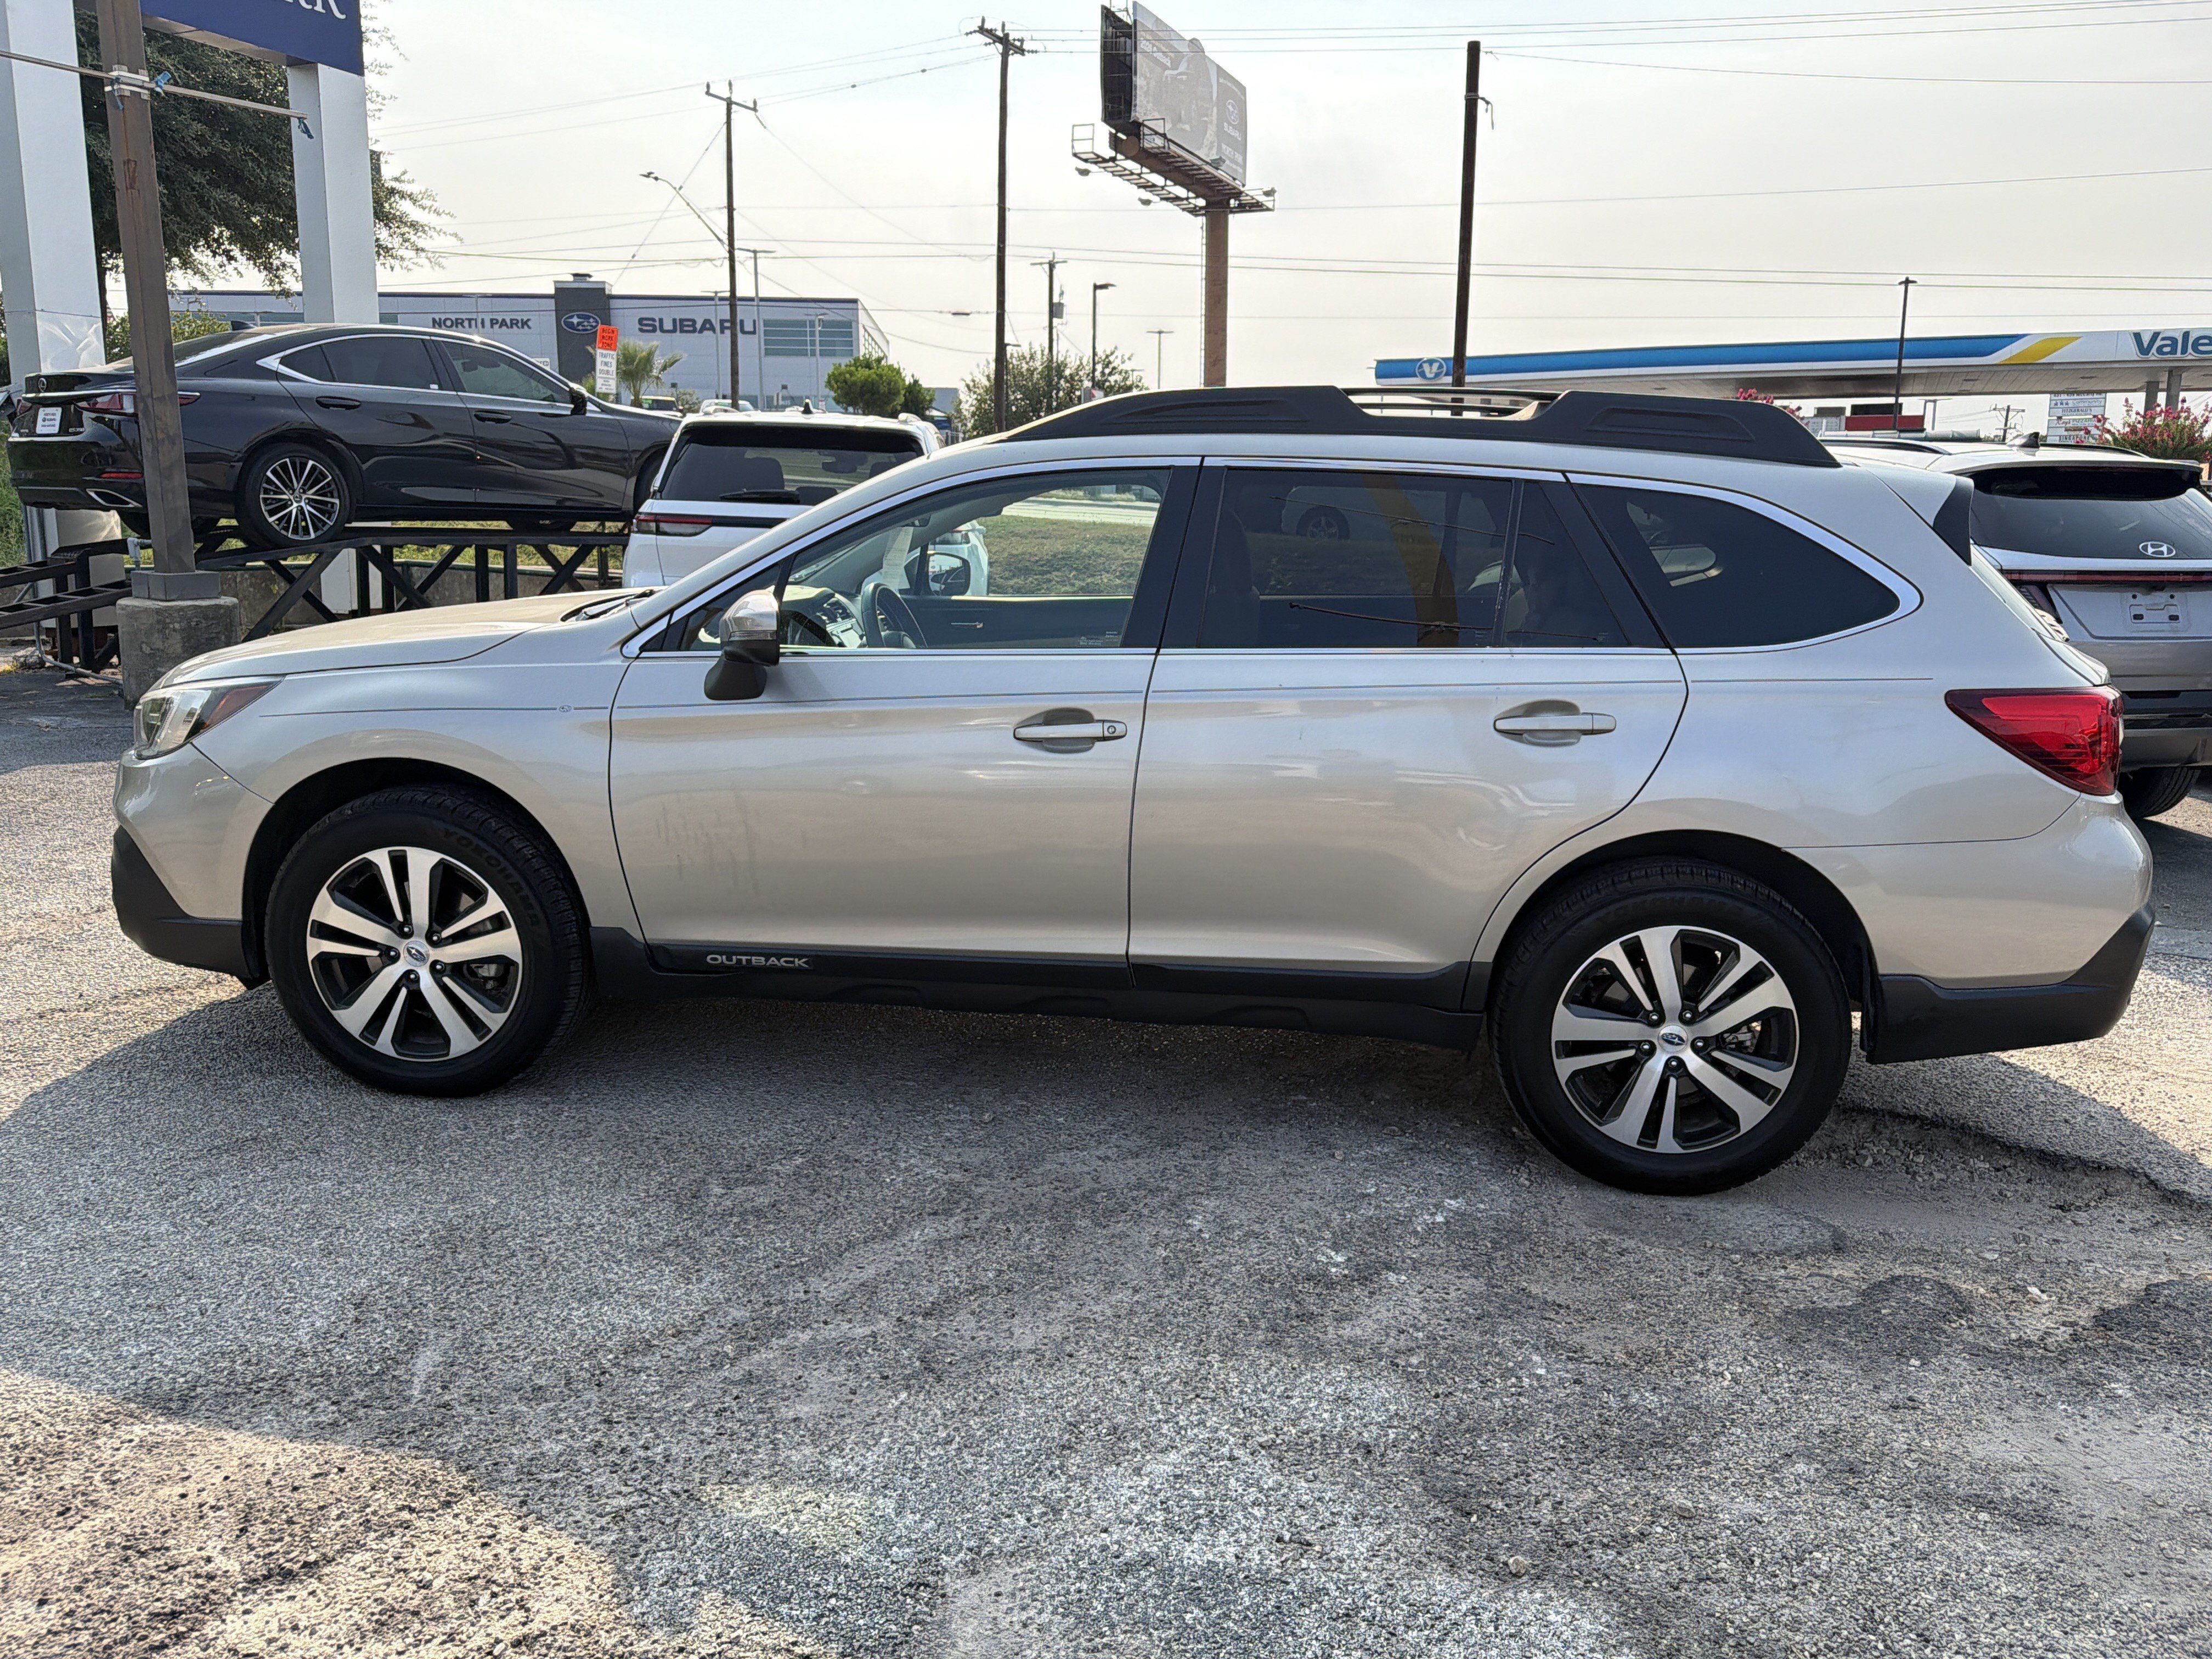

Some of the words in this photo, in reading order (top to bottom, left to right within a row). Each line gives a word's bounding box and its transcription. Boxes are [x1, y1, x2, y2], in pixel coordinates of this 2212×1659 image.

[432, 317, 485, 329] NORTH
[490, 318, 532, 329] PARK
[638, 317, 757, 335] SUBARU
[599, 352, 614, 360] TRAFFIC
[442, 828, 540, 927] YOKOHAMA
[707, 955, 809, 967] OUTBACK
